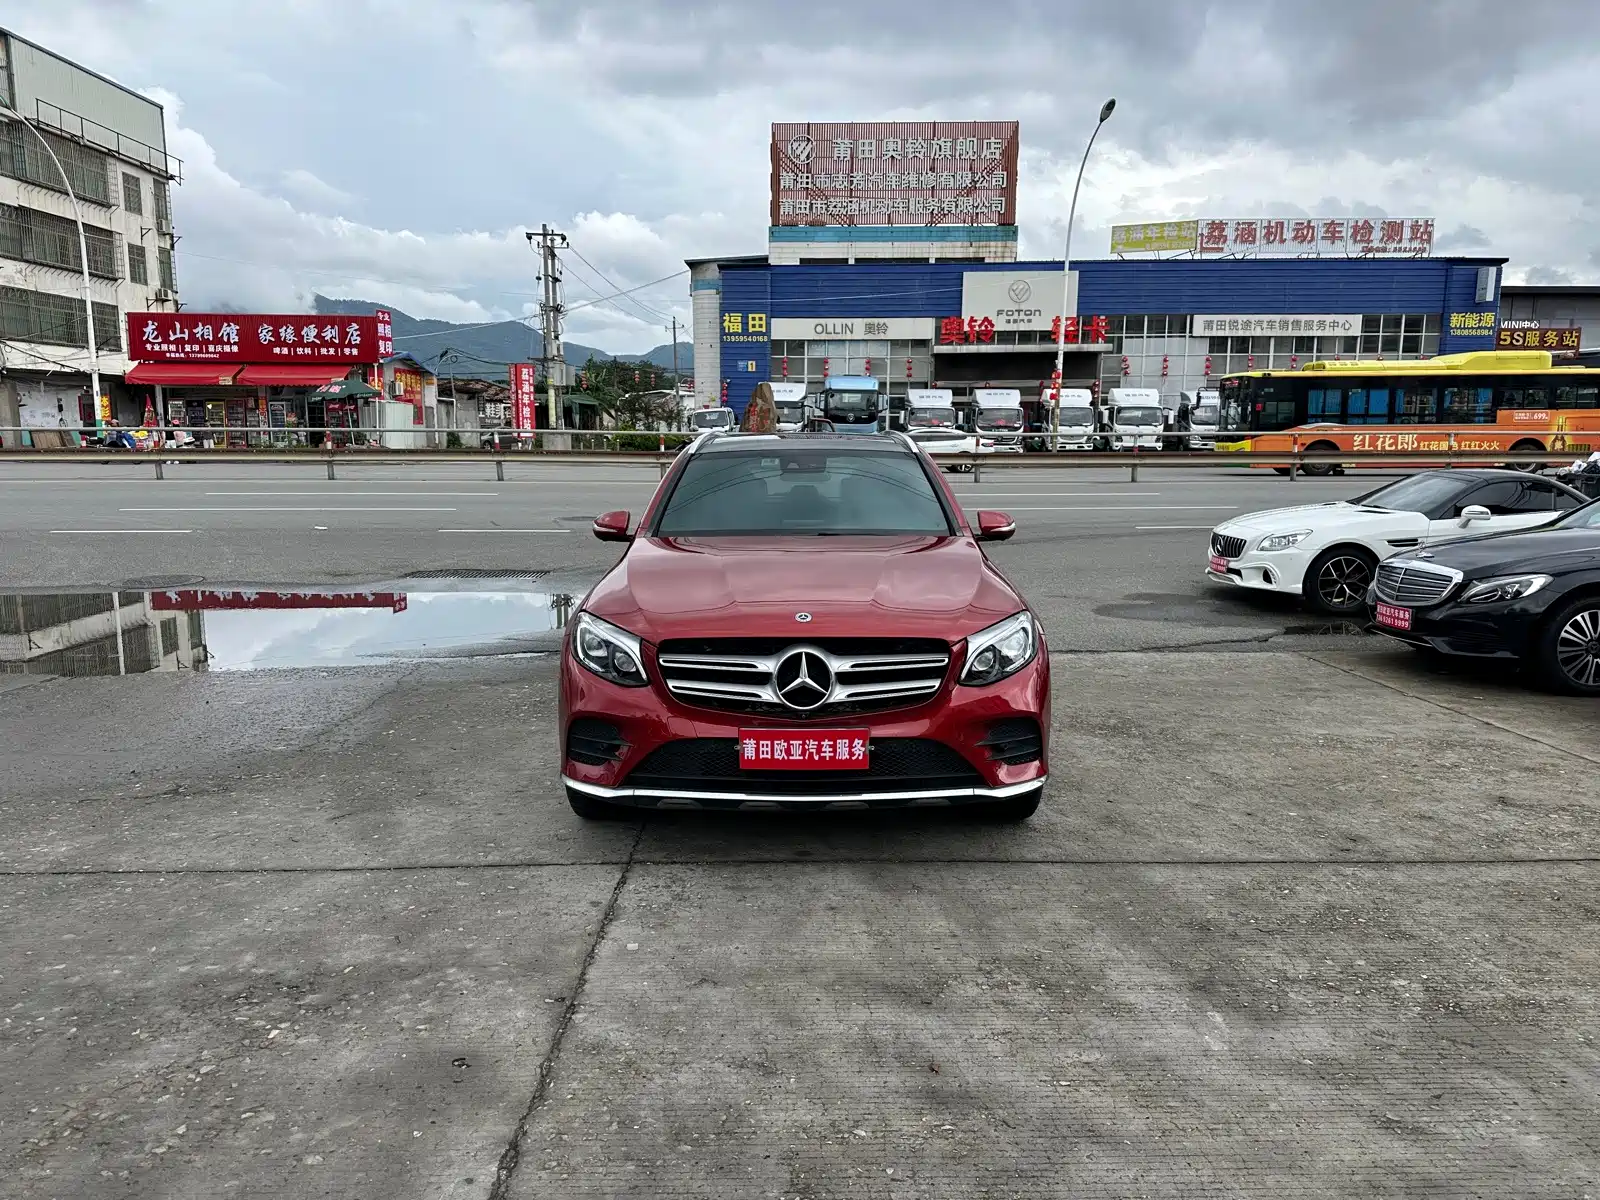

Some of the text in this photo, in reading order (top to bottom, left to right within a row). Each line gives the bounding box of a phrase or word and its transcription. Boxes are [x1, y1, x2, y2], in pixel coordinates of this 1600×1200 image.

[831, 137, 1003, 161] 莆田奥铃旗舰店
[1205, 219, 1434, 245] 荔涵机动车检测站
[996, 309, 1042, 317] FOTON
[1449, 312, 1495, 328] 新能源
[377, 323, 392, 338] 照相
[723, 312, 767, 333] 福田
[814, 322, 889, 336] OLLIN 奥铃
[940, 314, 1110, 344] 奥铃 轻卡
[1202, 318, 1353, 332] 莆田锐途汽车销售服务中心
[142, 320, 240, 344] 龙山相馆
[257, 323, 361, 345] 家缘便利店
[1499, 330, 1579, 347] 5S服务站
[145, 343, 177, 352] 专业照相
[184, 344, 200, 352] 复印
[343, 348, 359, 356] 零售
[378, 340, 393, 354] 复印
[1353, 433, 1418, 451] 红花郎
[1461, 441, 1500, 450] 红红火火
[743, 738, 866, 760] 莆田欧亚汽车服务
